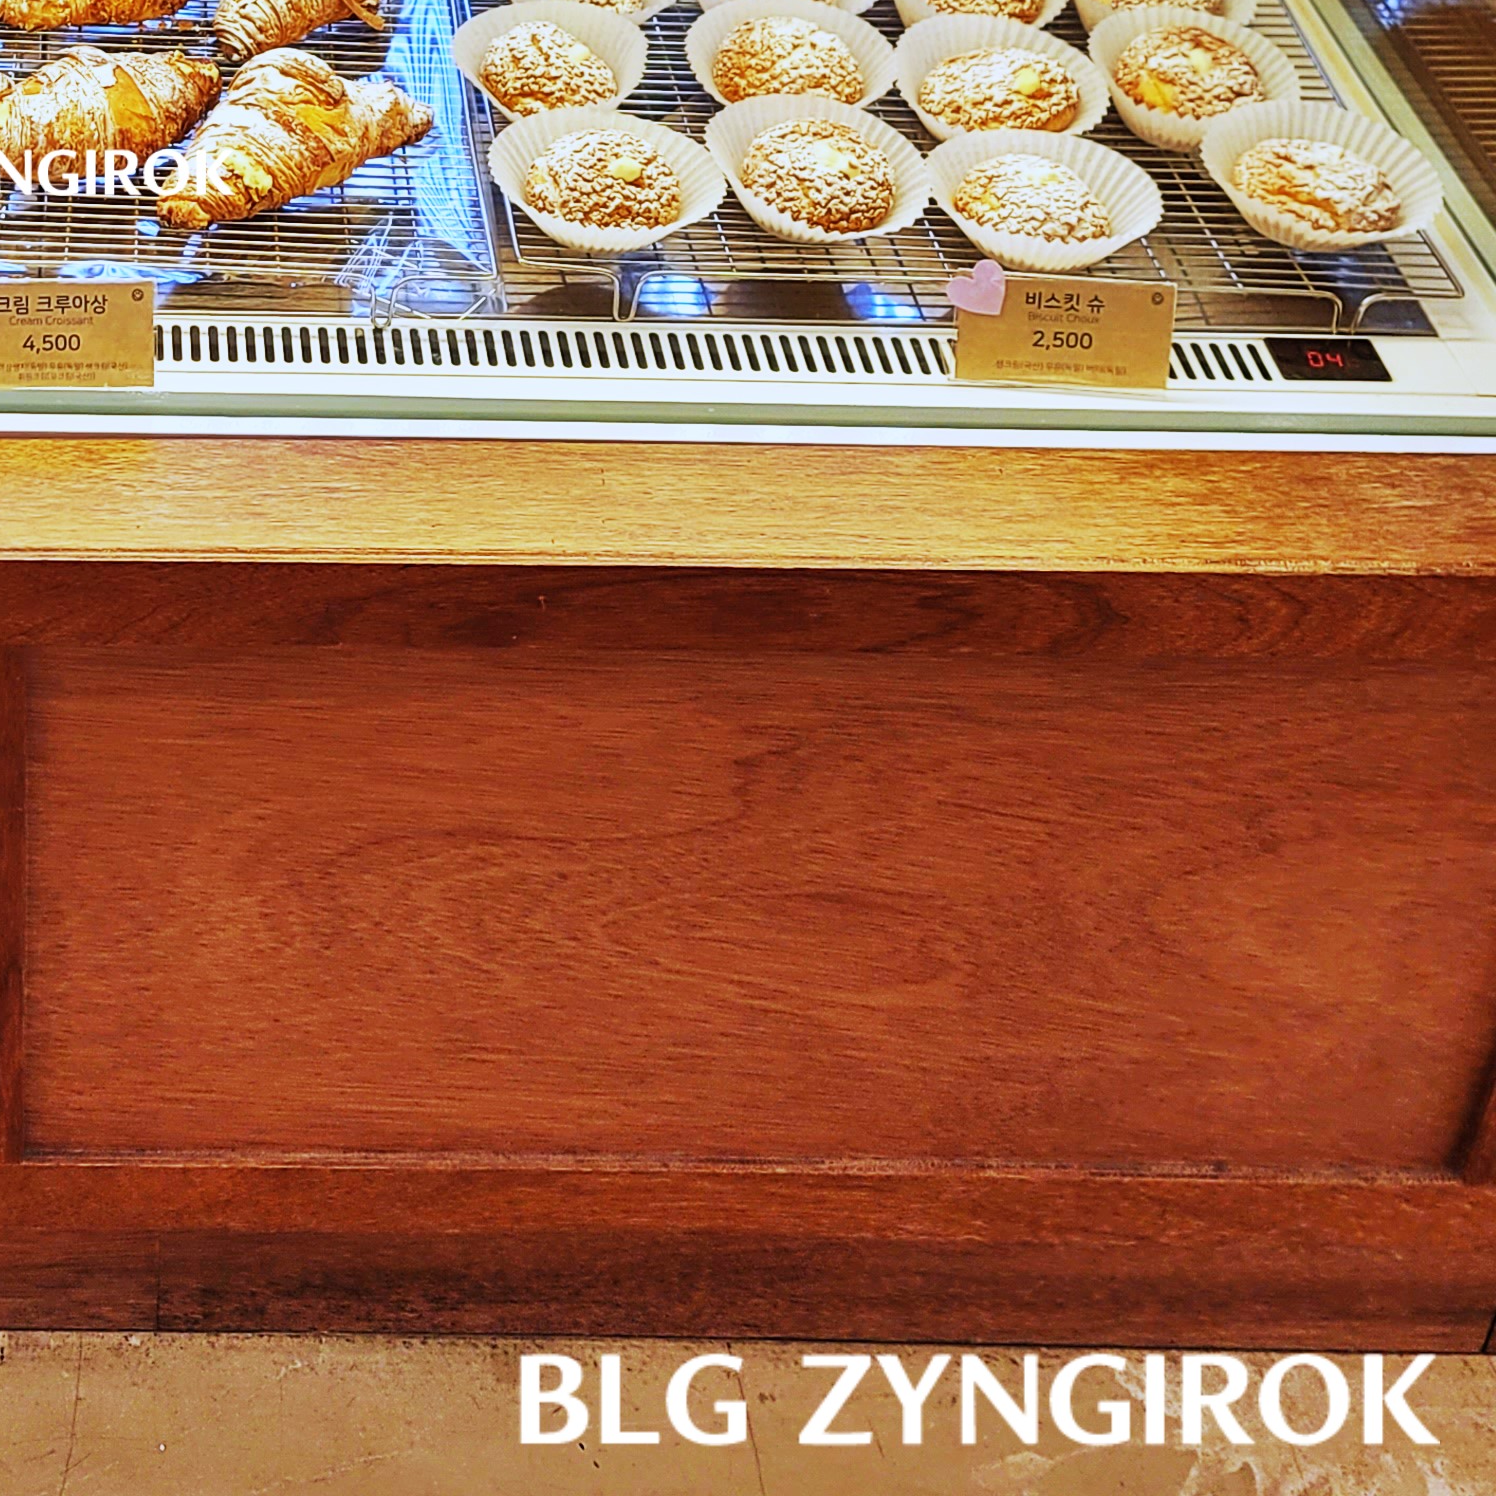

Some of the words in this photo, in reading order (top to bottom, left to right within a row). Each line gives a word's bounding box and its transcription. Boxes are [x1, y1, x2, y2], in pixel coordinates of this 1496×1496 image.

[36, 294, 108, 315] 크루아상
[1025, 291, 1080, 313] 비스킷
[1087, 296, 1106, 314] 슈
[9, 315, 43, 326] Cream
[45, 315, 94, 326] Croissant
[1027, 312, 1064, 324] Biscuit
[1066, 312, 1101, 324] Choux
[22, 334, 81, 354] 4,500
[1031, 330, 1093, 351] 2,500
[1305, 350, 1344, 368] 04
